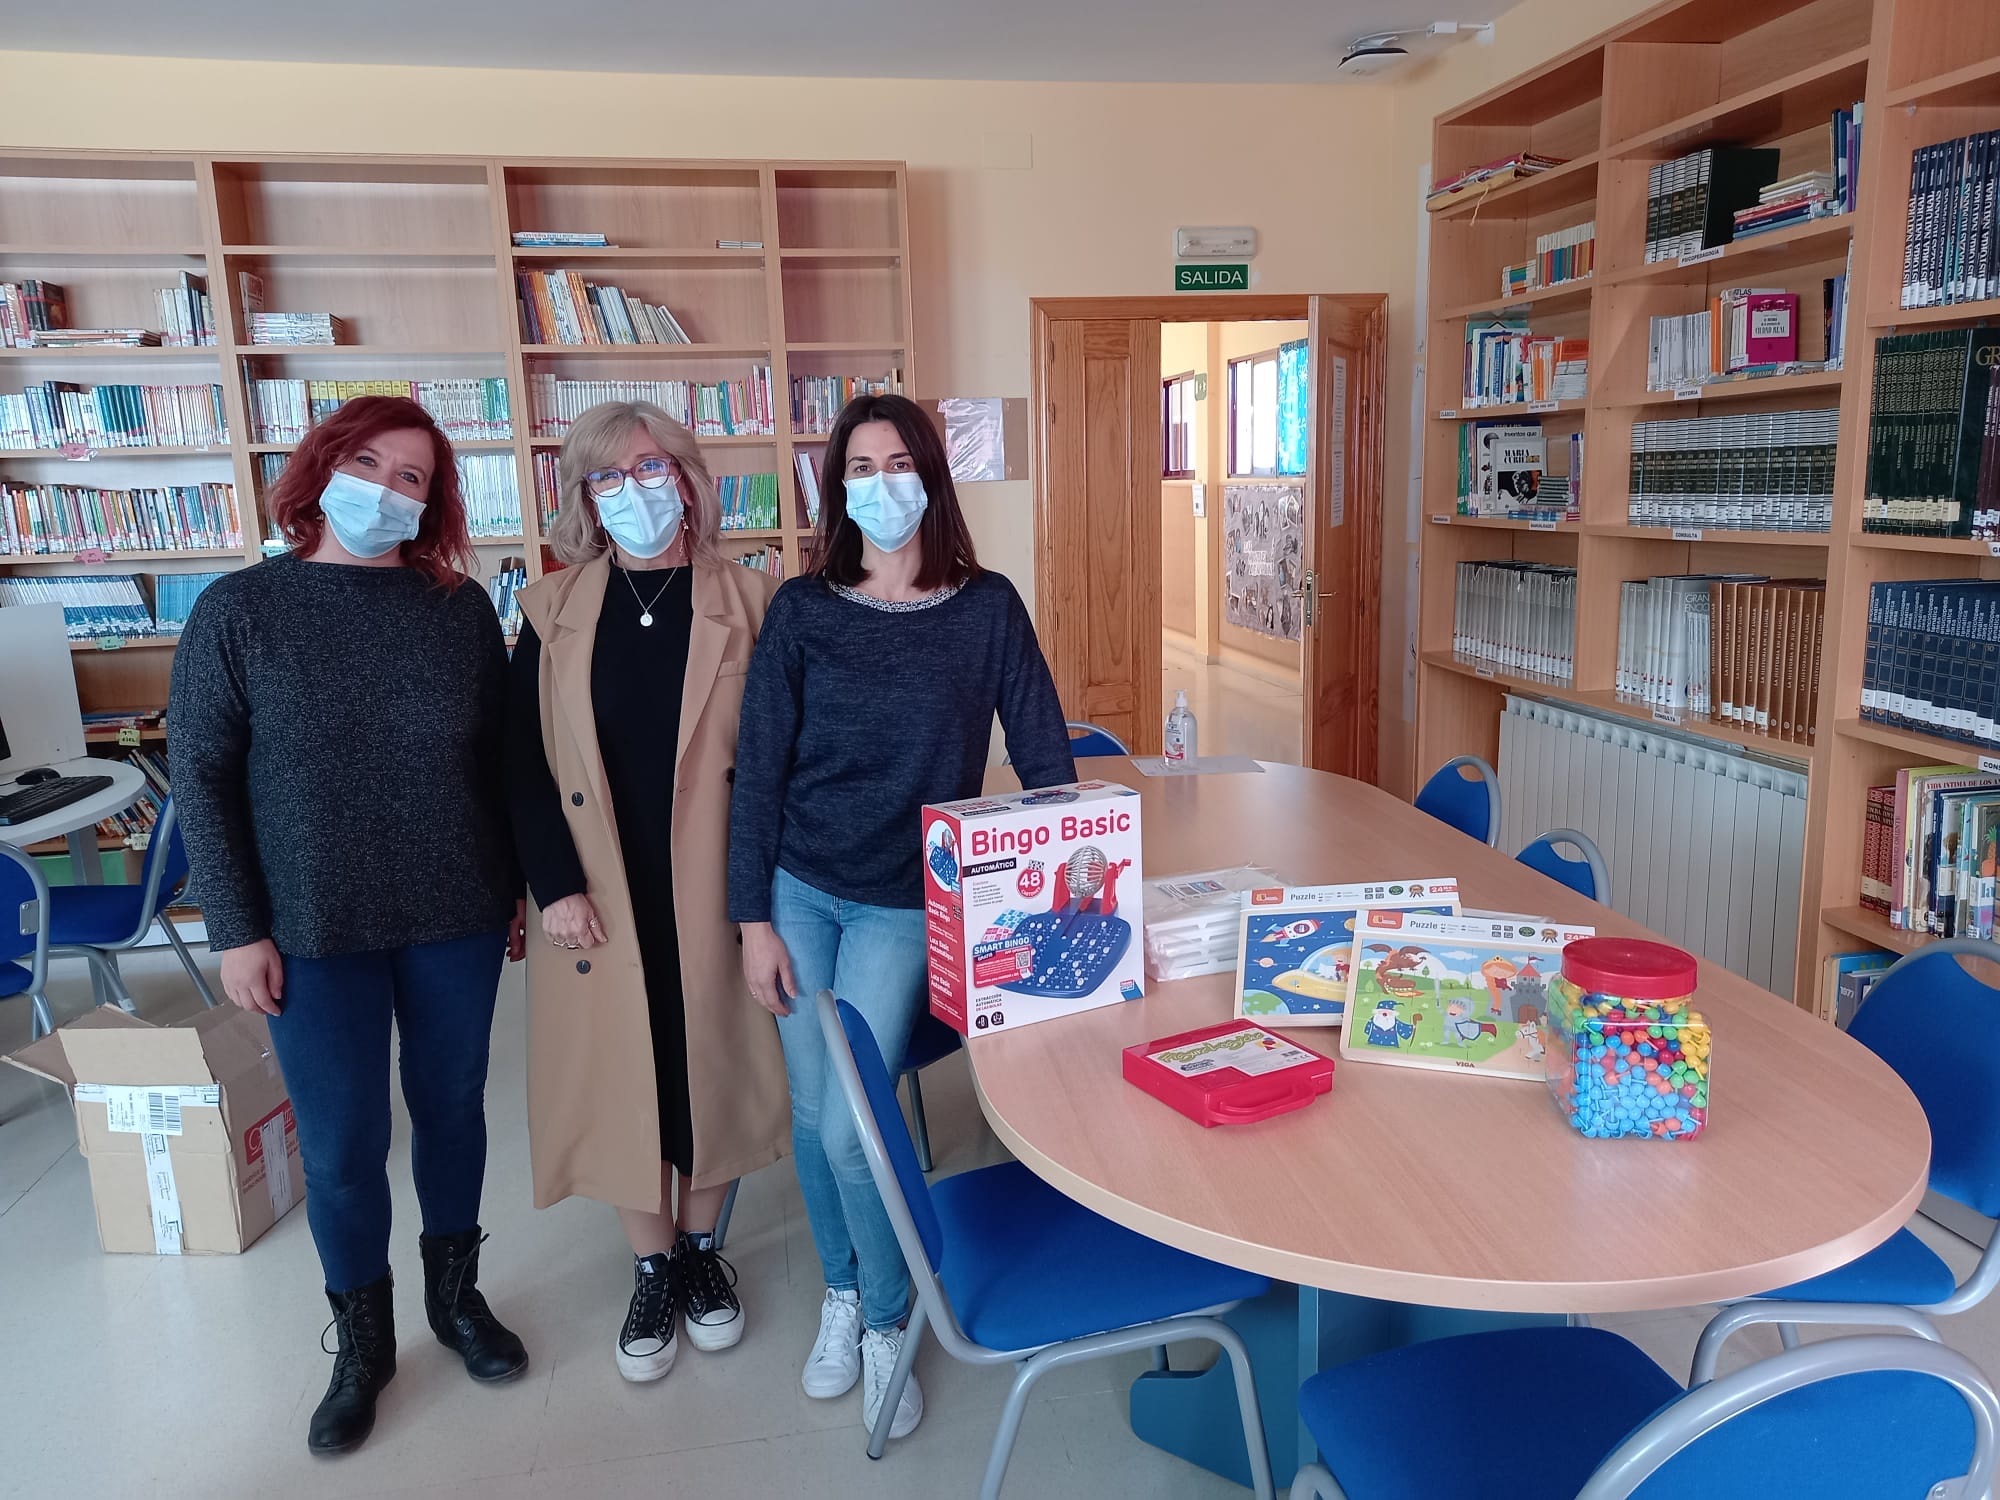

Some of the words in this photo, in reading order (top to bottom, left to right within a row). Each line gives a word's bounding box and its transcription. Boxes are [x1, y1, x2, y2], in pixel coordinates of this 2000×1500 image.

[1180, 270, 1243, 284] SALIDA
[971, 827, 1050, 856] Bingo
[1061, 809, 1130, 841] Basic
[971, 861, 1014, 874] AUTOMÁTICO
[1020, 872, 1040, 888] 48
[1290, 893, 1316, 901] Puzzle
[1410, 920, 1438, 929] Puzzle
[974, 942, 1003, 955] SMART
[1004, 937, 1029, 948] BINGO
